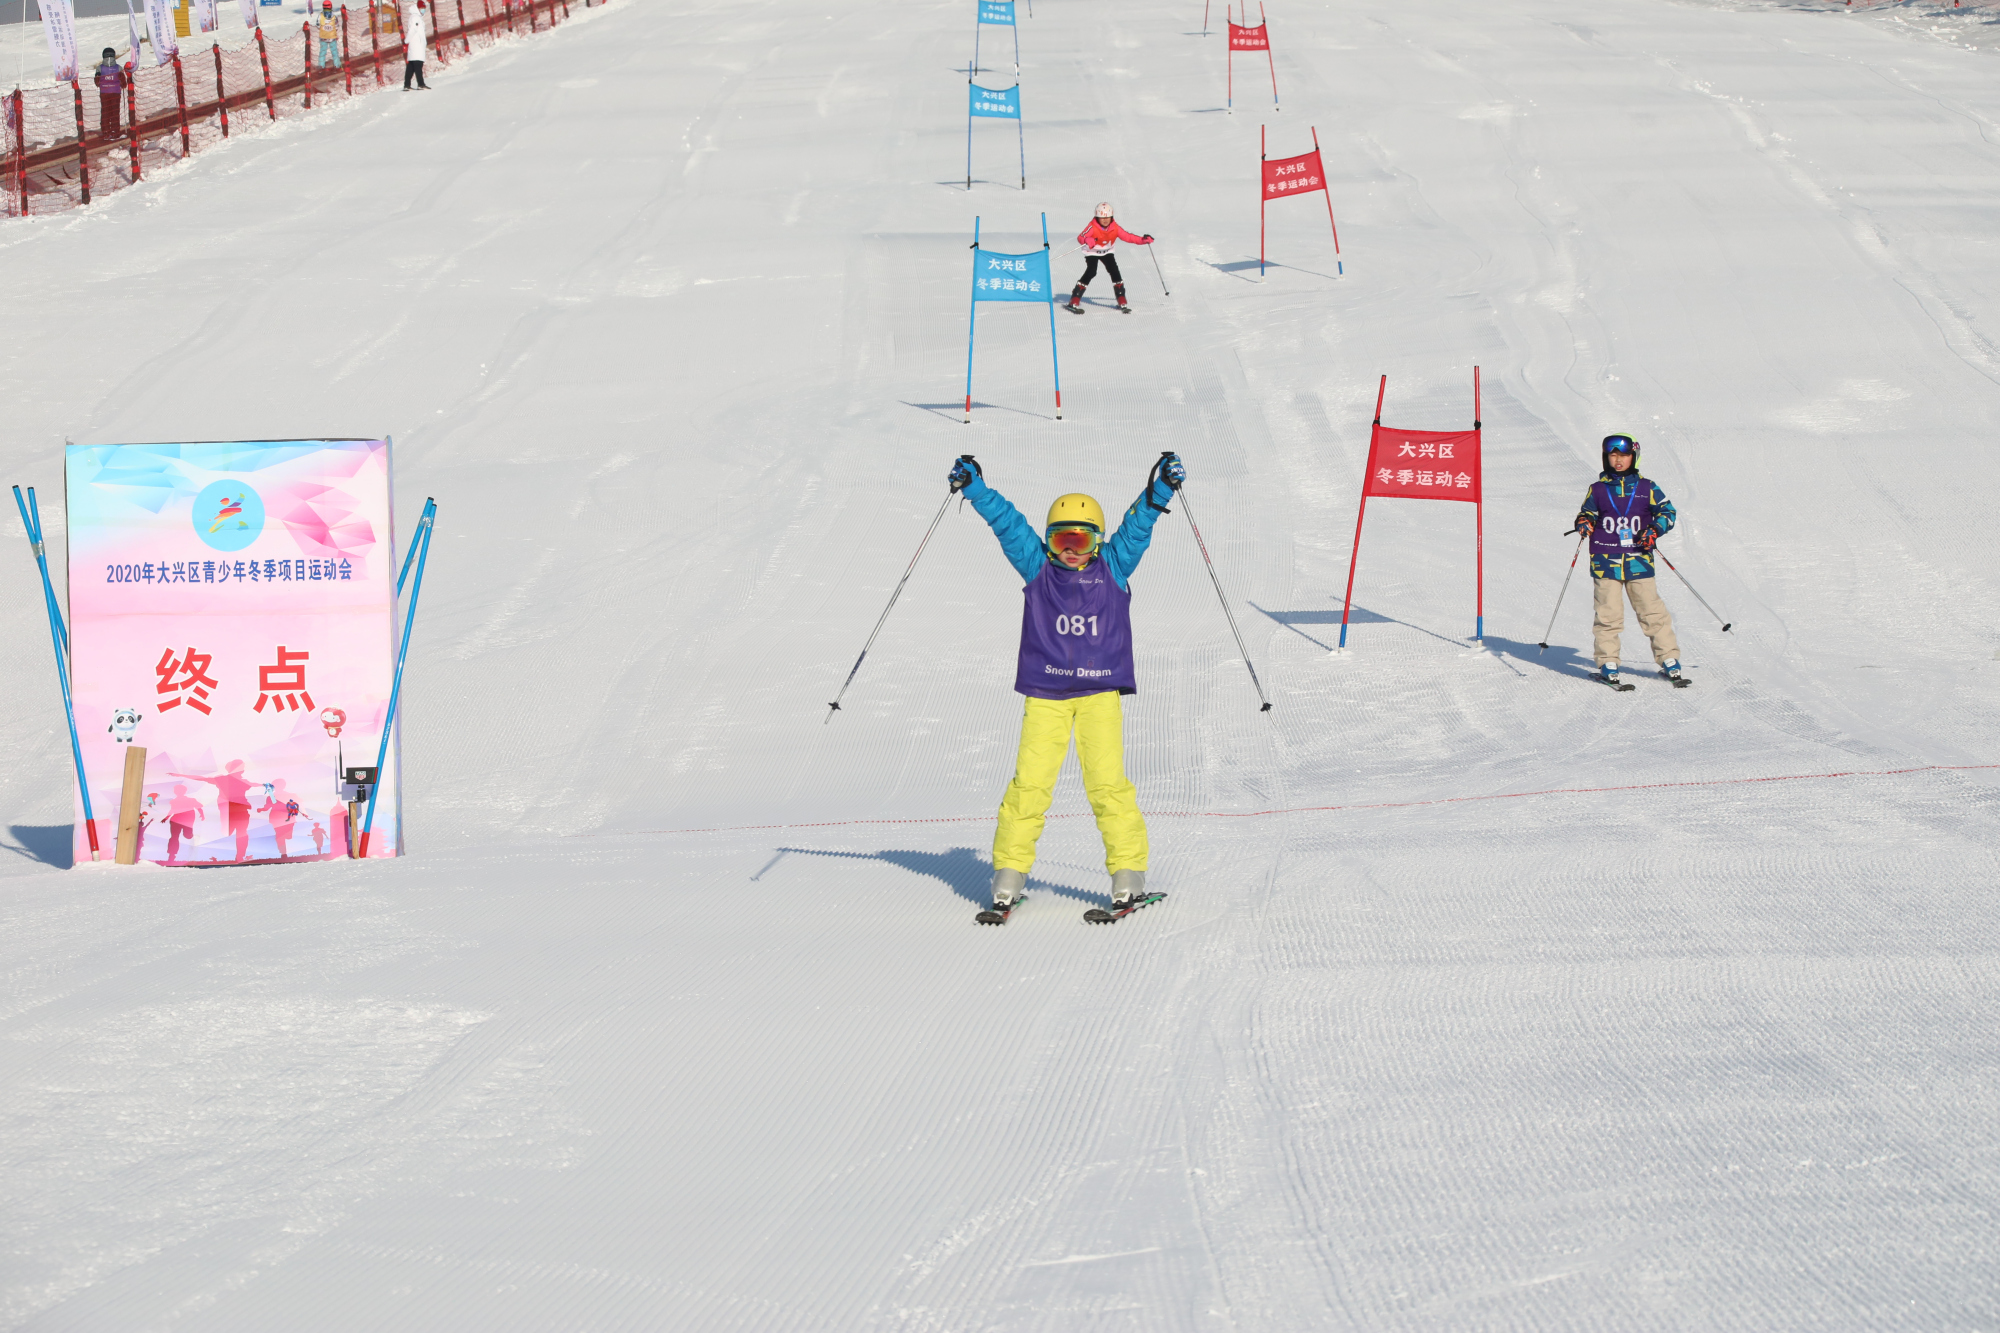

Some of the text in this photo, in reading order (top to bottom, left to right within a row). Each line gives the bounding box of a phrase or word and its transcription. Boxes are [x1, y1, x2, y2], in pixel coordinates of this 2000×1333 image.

[982, 91, 1006, 100] 大兴区
[974, 101, 1015, 113] 冬季运动会
[1275, 162, 1307, 177] 大兴区
[1267, 175, 1319, 193] 冬季运动会
[988, 258, 1027, 272] 大兴区
[976, 277, 1041, 292] 冬季运动会
[1397, 441, 1455, 459] 大兴区
[1376, 467, 1472, 489] 冬季运动会
[1602, 515, 1641, 535] 080
[106, 557, 353, 585] 2020年大兴区青少年冬季项目运动会
[1055, 614, 1099, 636] 081
[1045, 664, 1112, 678] Snow Dream
